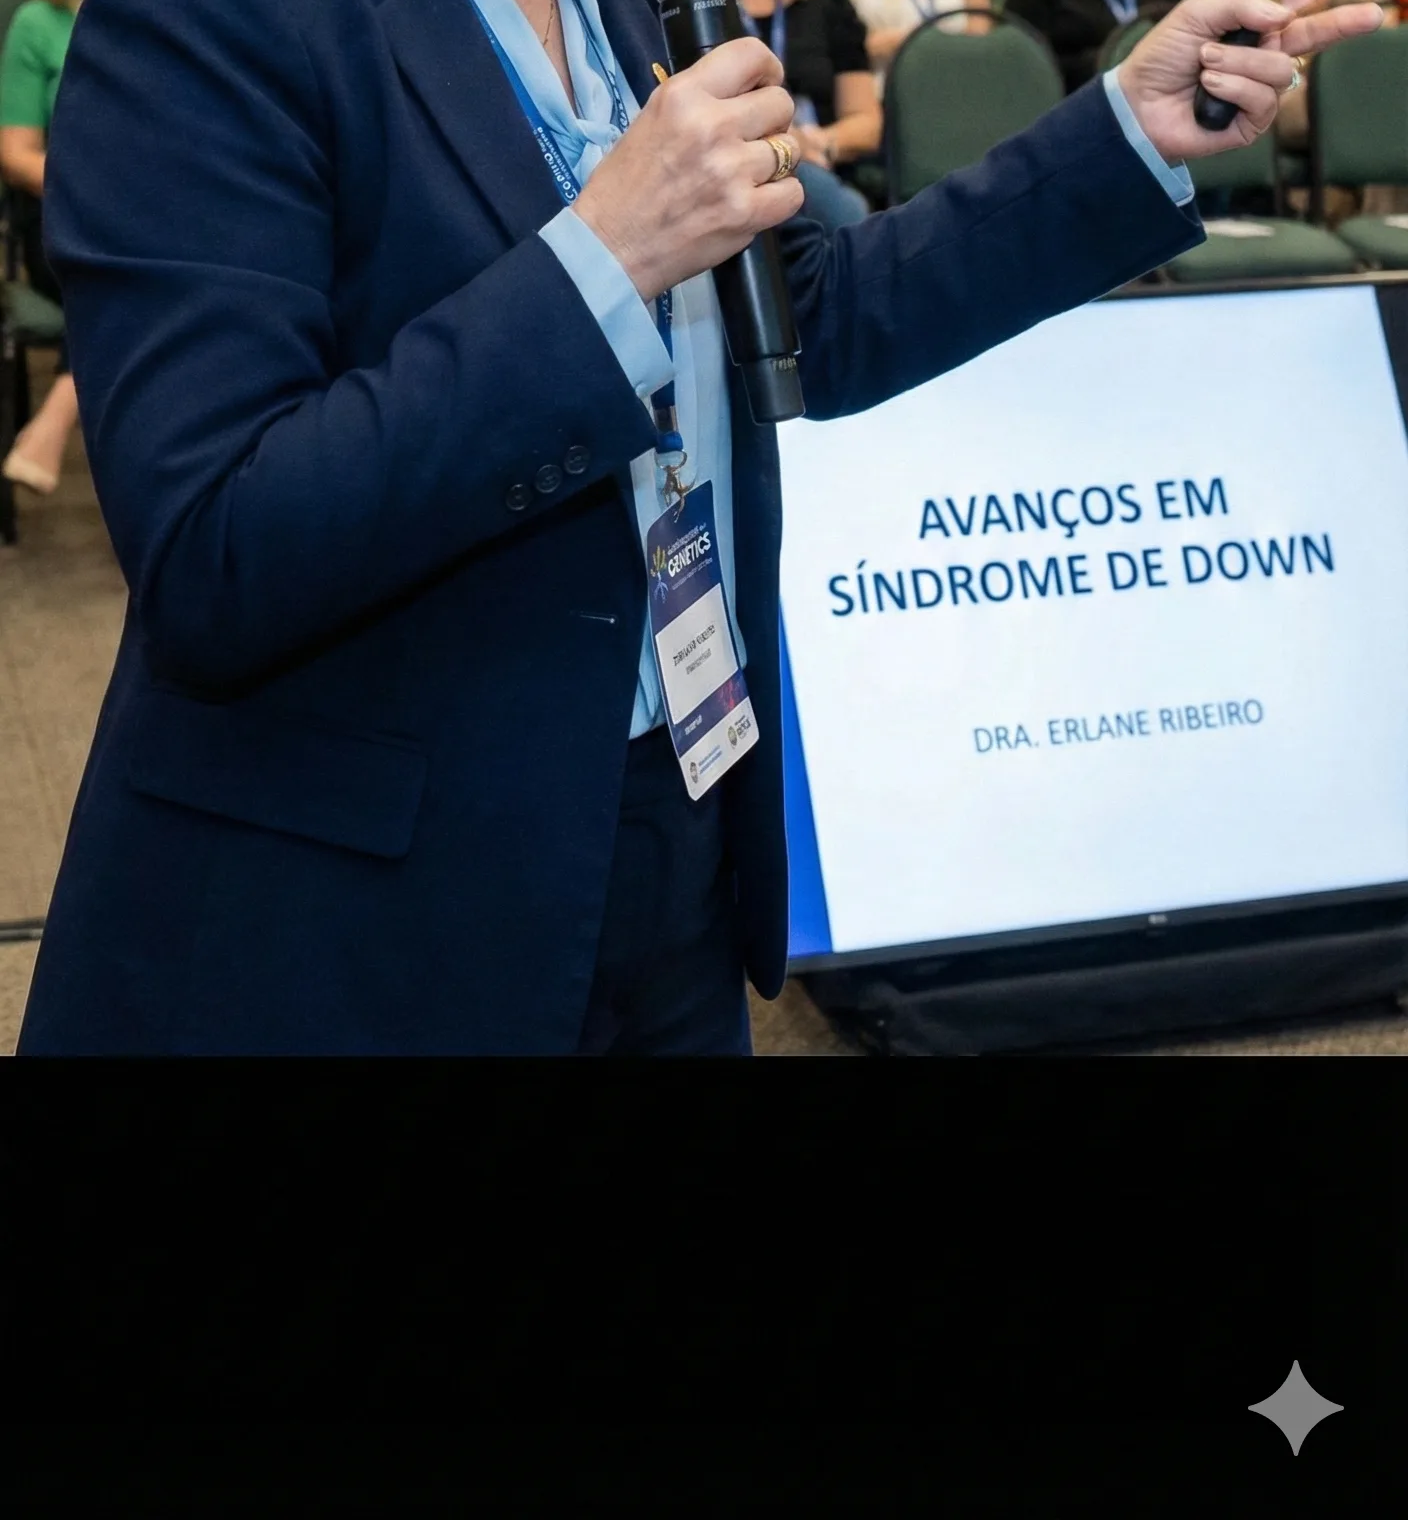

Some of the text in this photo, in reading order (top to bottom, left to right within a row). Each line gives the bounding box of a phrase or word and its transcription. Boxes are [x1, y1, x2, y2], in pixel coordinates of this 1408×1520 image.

[918, 476, 1229, 540] AVANÇOS EM
[827, 532, 1336, 618] SÍNDROME DE DOWN
[973, 698, 1265, 754] DRA. ERLANE RIBEIRO
